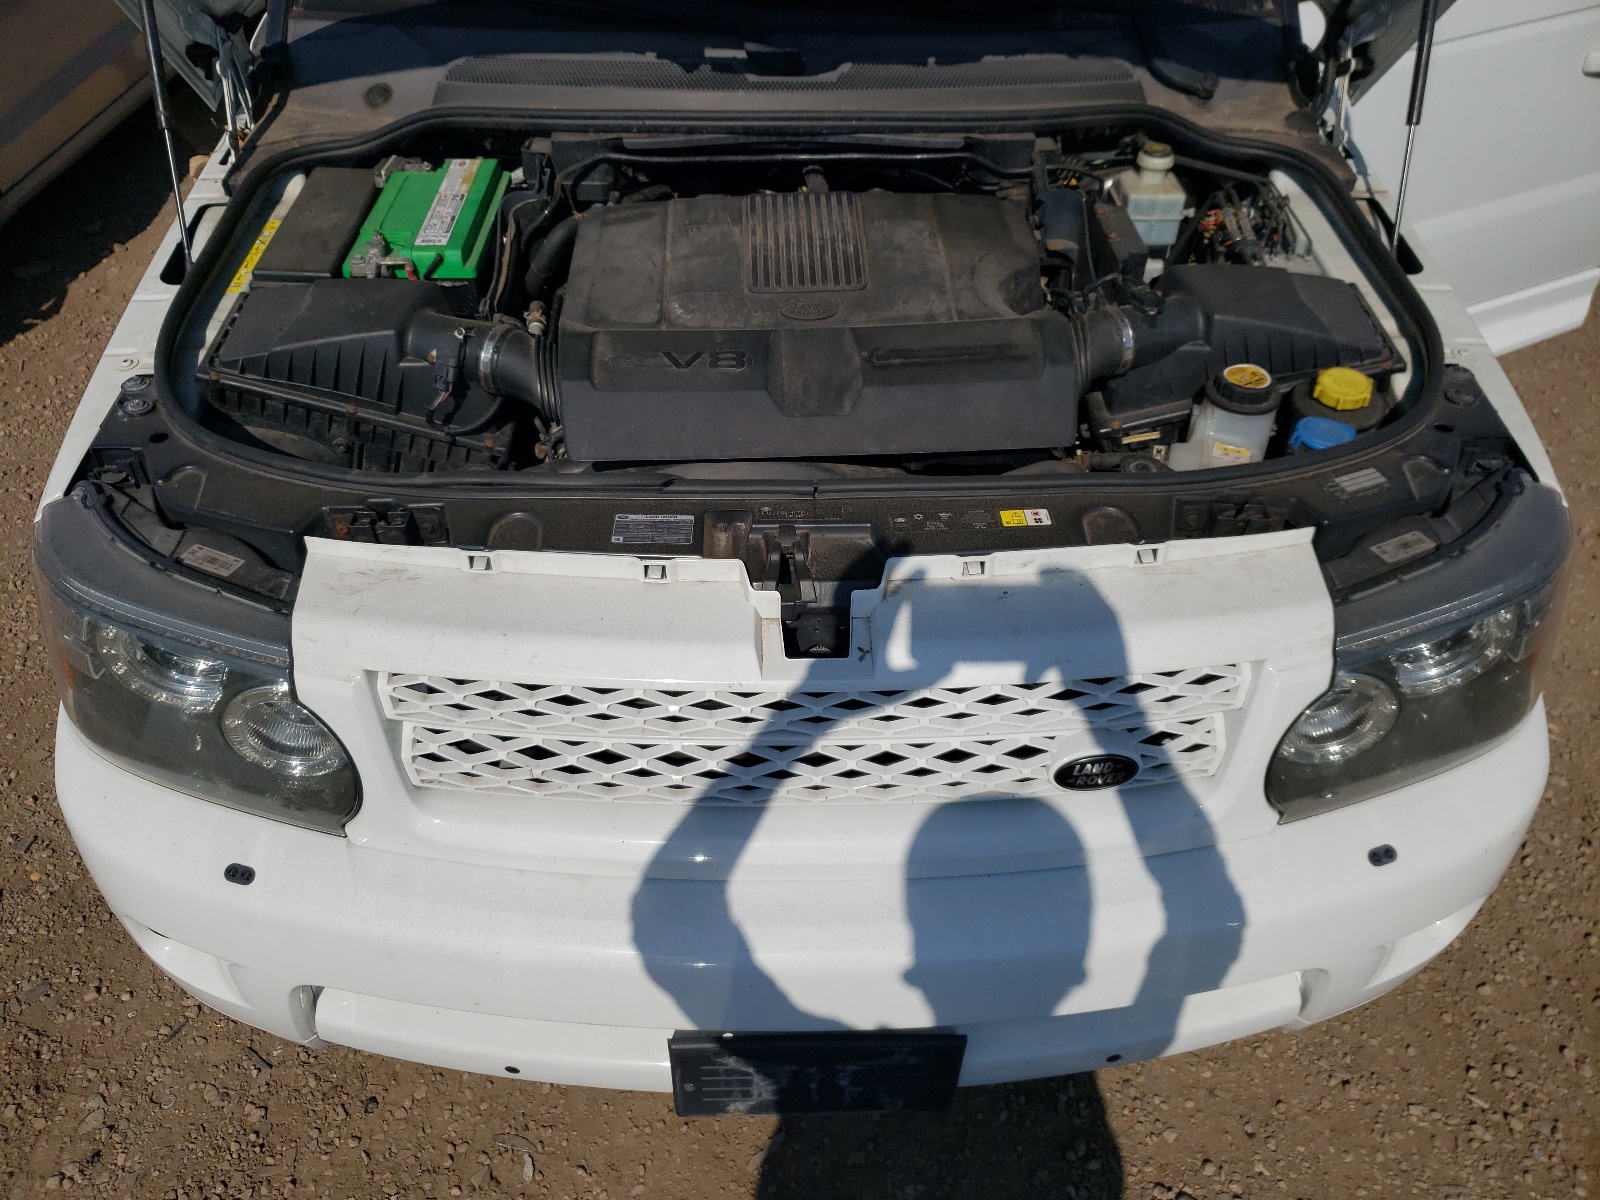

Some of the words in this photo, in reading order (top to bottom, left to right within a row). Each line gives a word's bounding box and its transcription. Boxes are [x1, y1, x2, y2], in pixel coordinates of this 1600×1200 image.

[661, 350, 746, 370] V8
[1072, 761, 1115, 776] LAND
[1074, 771, 1126, 786] ROVER
